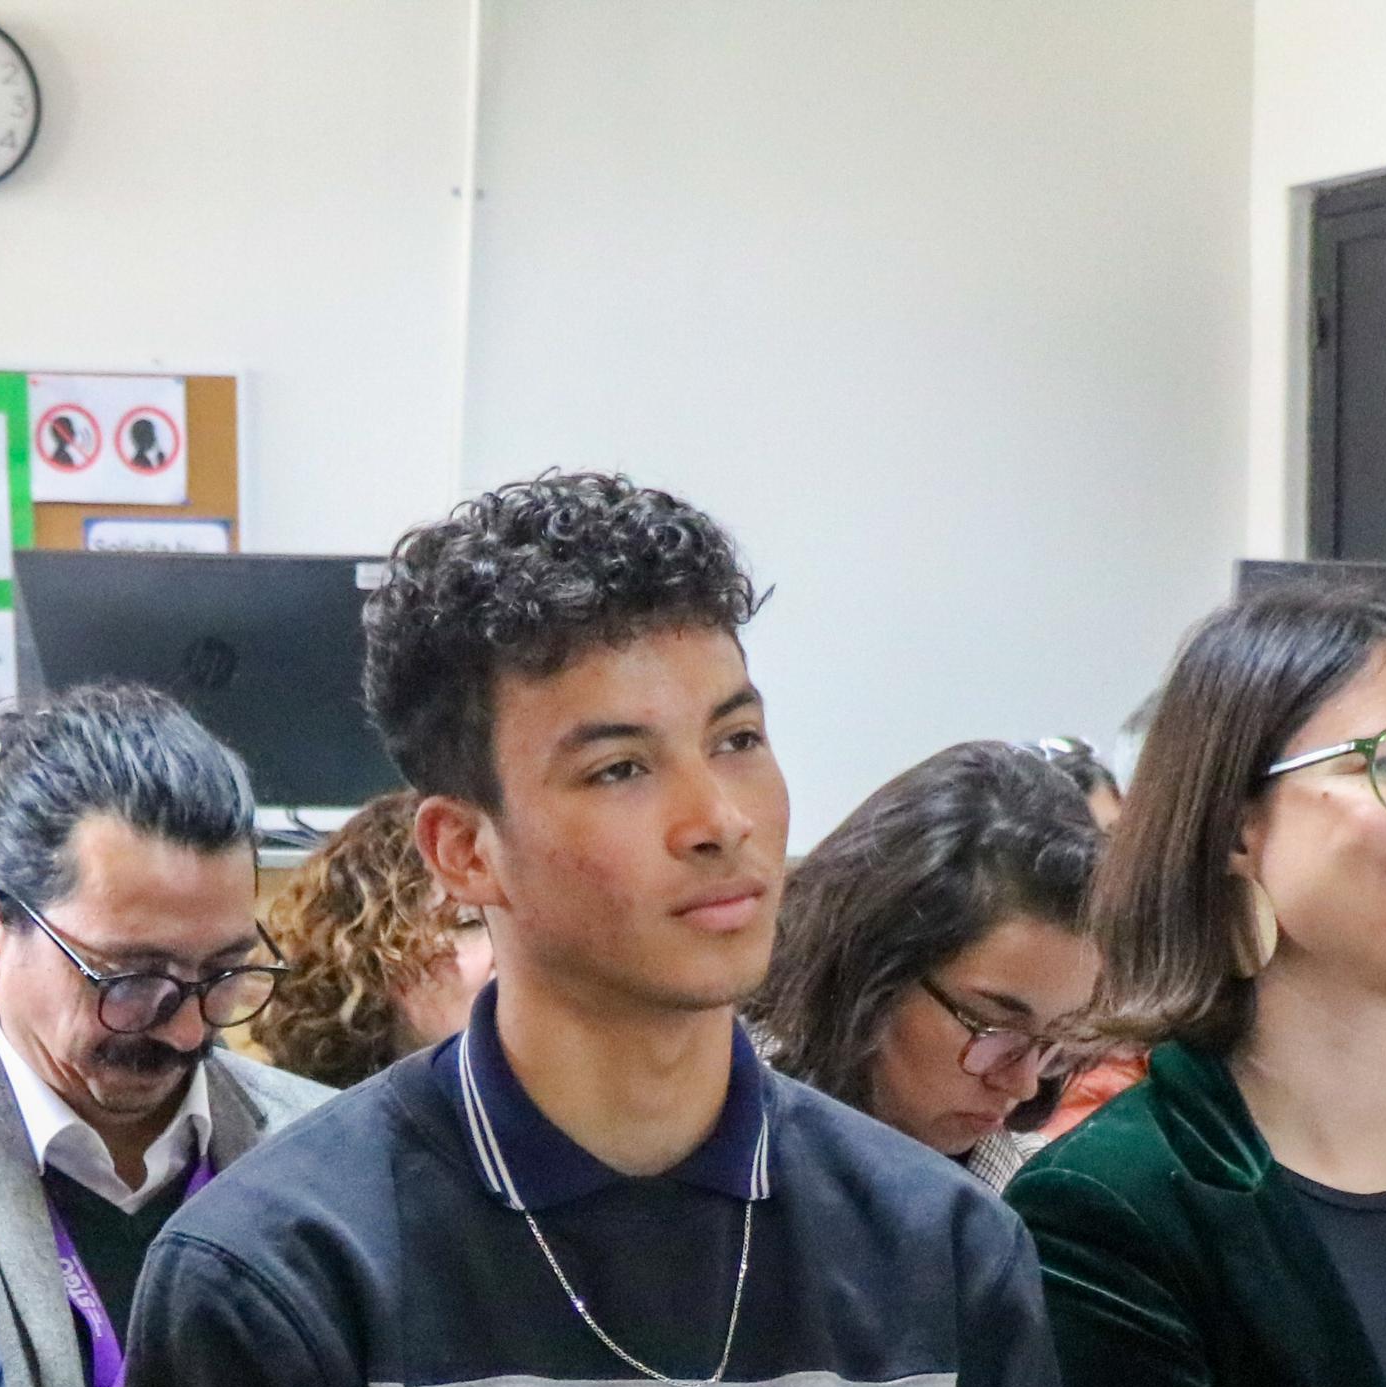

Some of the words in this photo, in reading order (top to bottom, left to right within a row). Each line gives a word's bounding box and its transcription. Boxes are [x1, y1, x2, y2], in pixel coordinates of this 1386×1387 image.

[2, 63, 20, 86] 2
[12, 94, 27, 118] 3
[0, 129, 16, 150] 4
